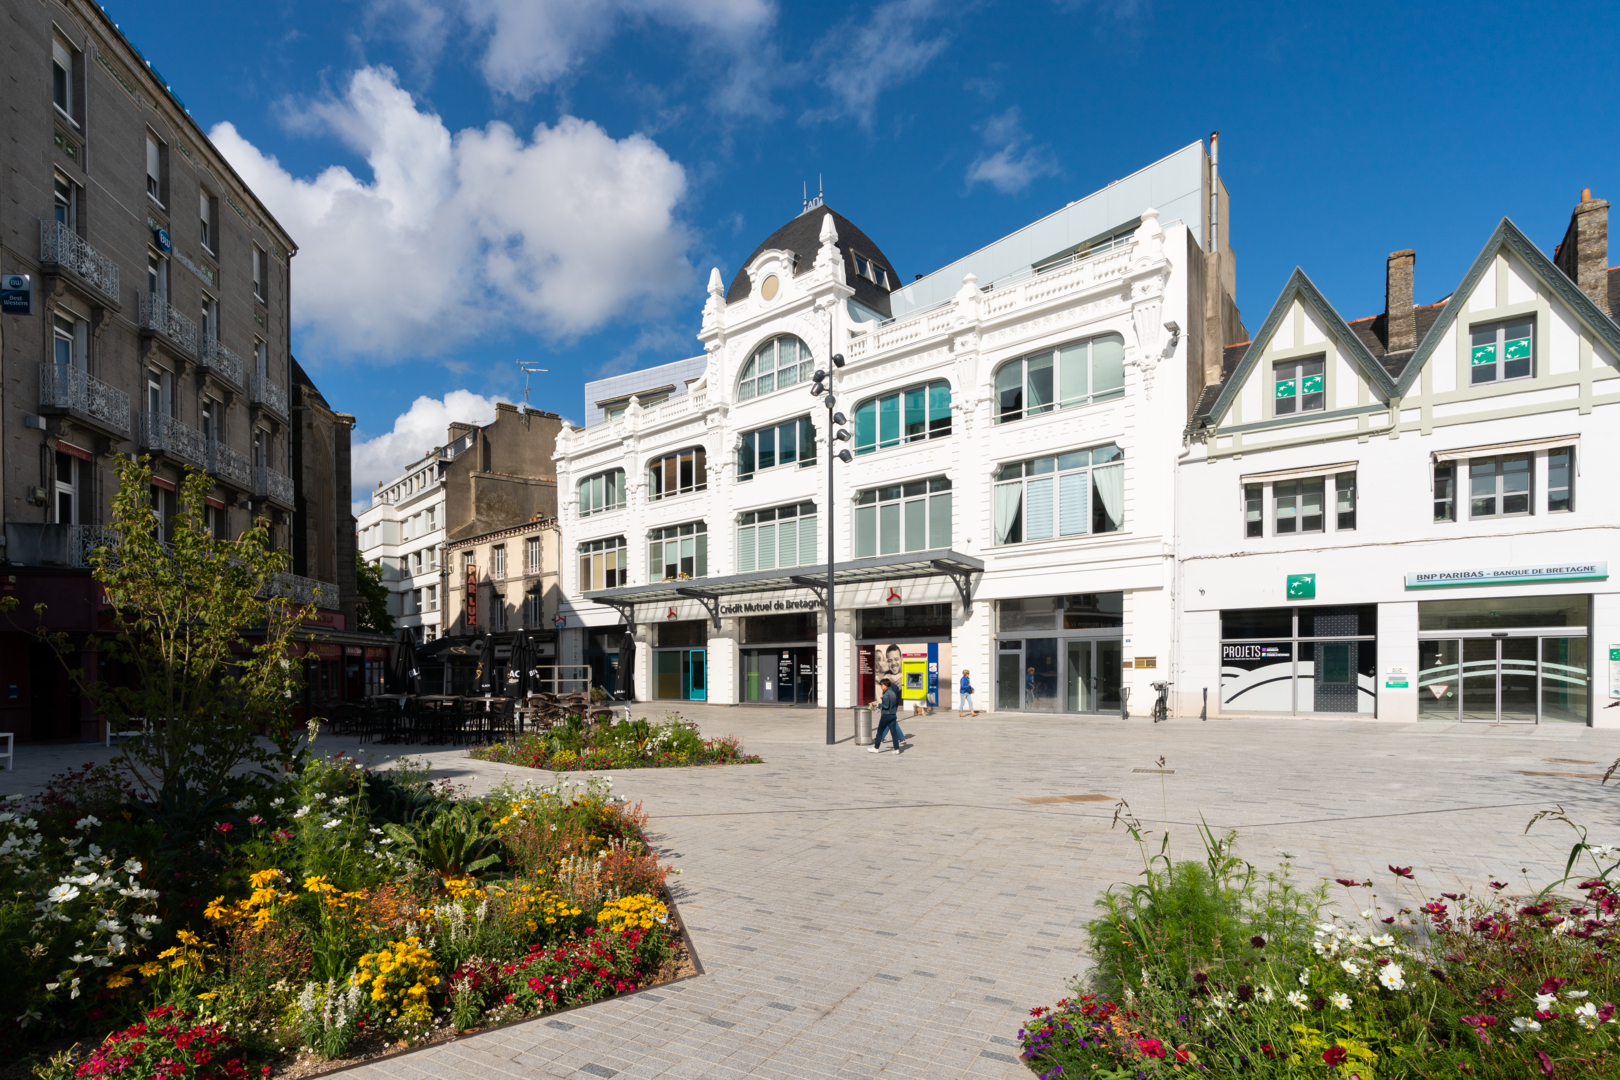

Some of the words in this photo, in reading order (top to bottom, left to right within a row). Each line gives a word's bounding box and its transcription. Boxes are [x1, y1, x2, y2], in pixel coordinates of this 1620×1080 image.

[160, 234, 171, 248] BW
[1439, 570, 1484, 579] PARIBAS
[1493, 569, 1529, 577] BANQUE
[1546, 565, 1596, 574] BRETAGNE
[720, 603, 743, 614] Crédit
[744, 601, 772, 613] Mutuel
[774, 600, 784, 610] de
[1223, 645, 1261, 657] PROJETS
